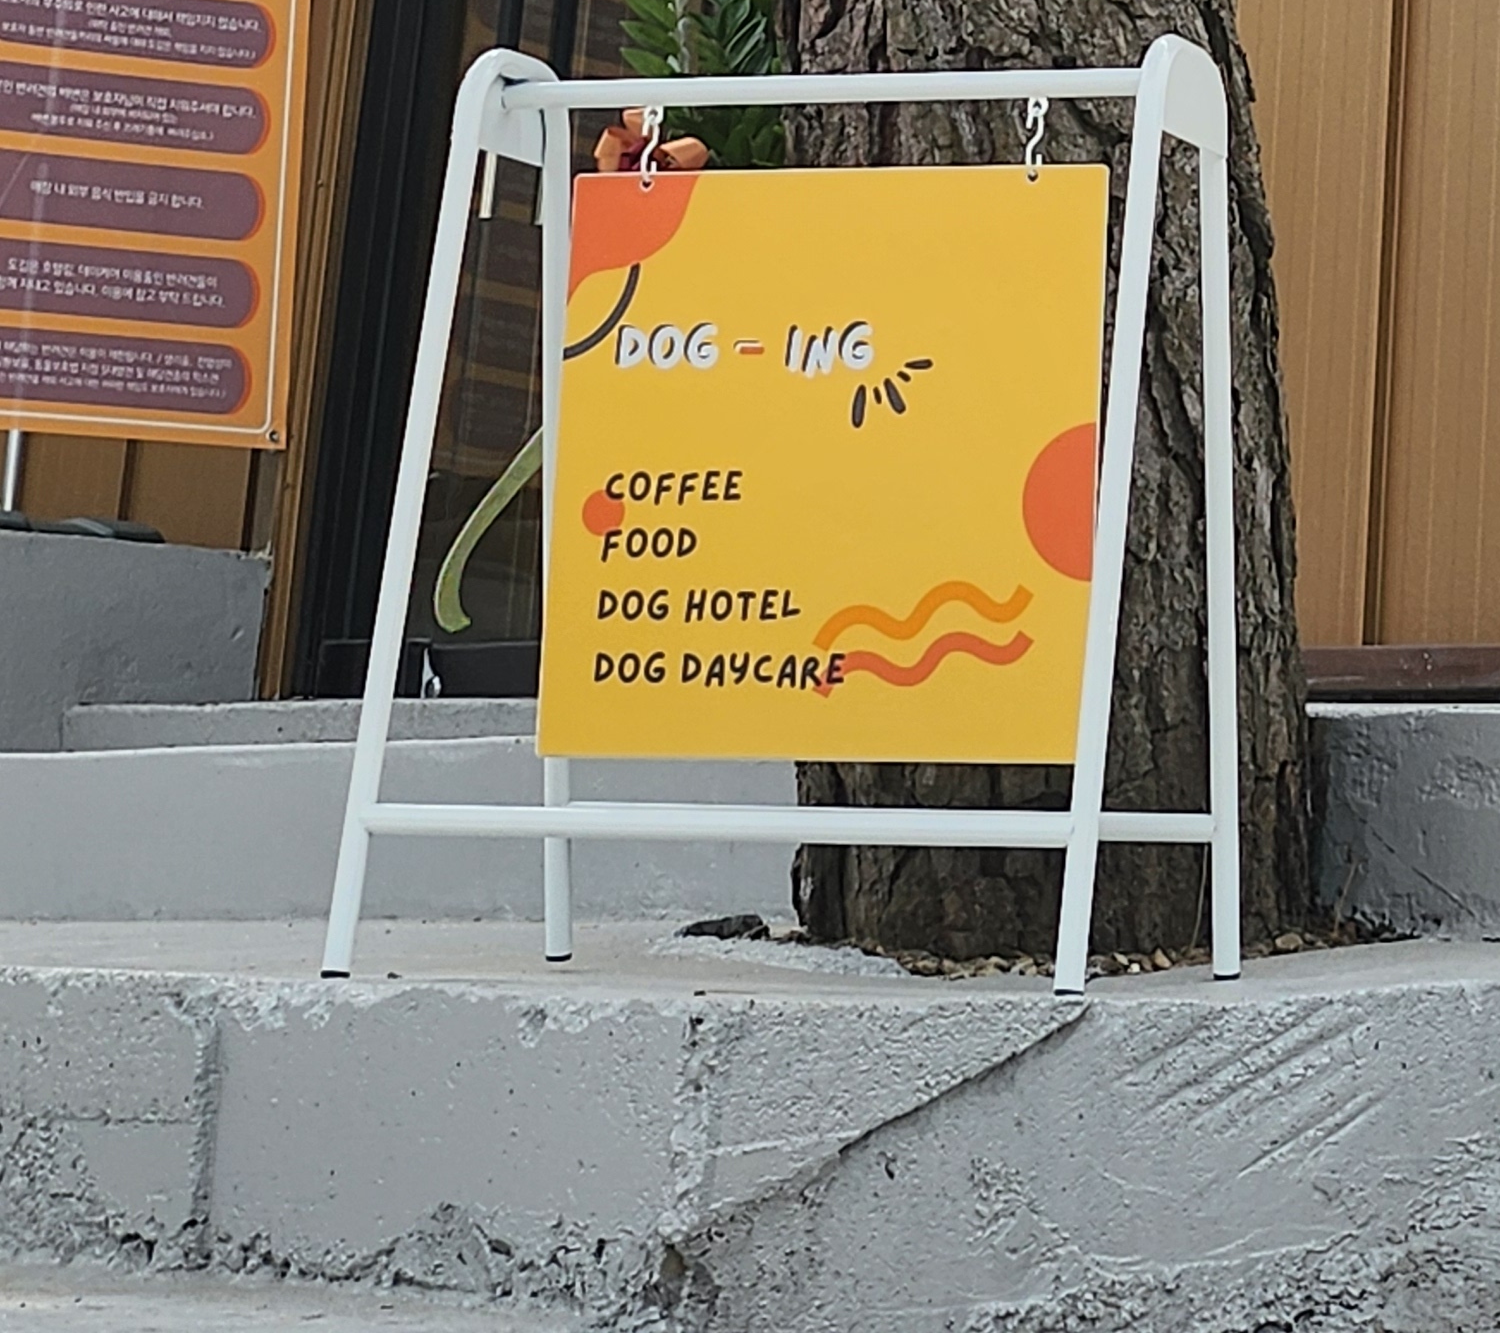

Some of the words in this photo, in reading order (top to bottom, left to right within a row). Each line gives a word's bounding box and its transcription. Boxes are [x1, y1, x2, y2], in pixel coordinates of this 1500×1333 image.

[0, 79, 13, 94] 인
[614, 323, 719, 369] DOG
[785, 321, 874, 377] ING
[605, 470, 743, 506] COFFEE
[600, 527, 698, 563] FOOD
[596, 588, 670, 621] DOG
[684, 588, 801, 623] HOTEL
[593, 652, 666, 685] DOG
[681, 651, 847, 689] DAYCARE
